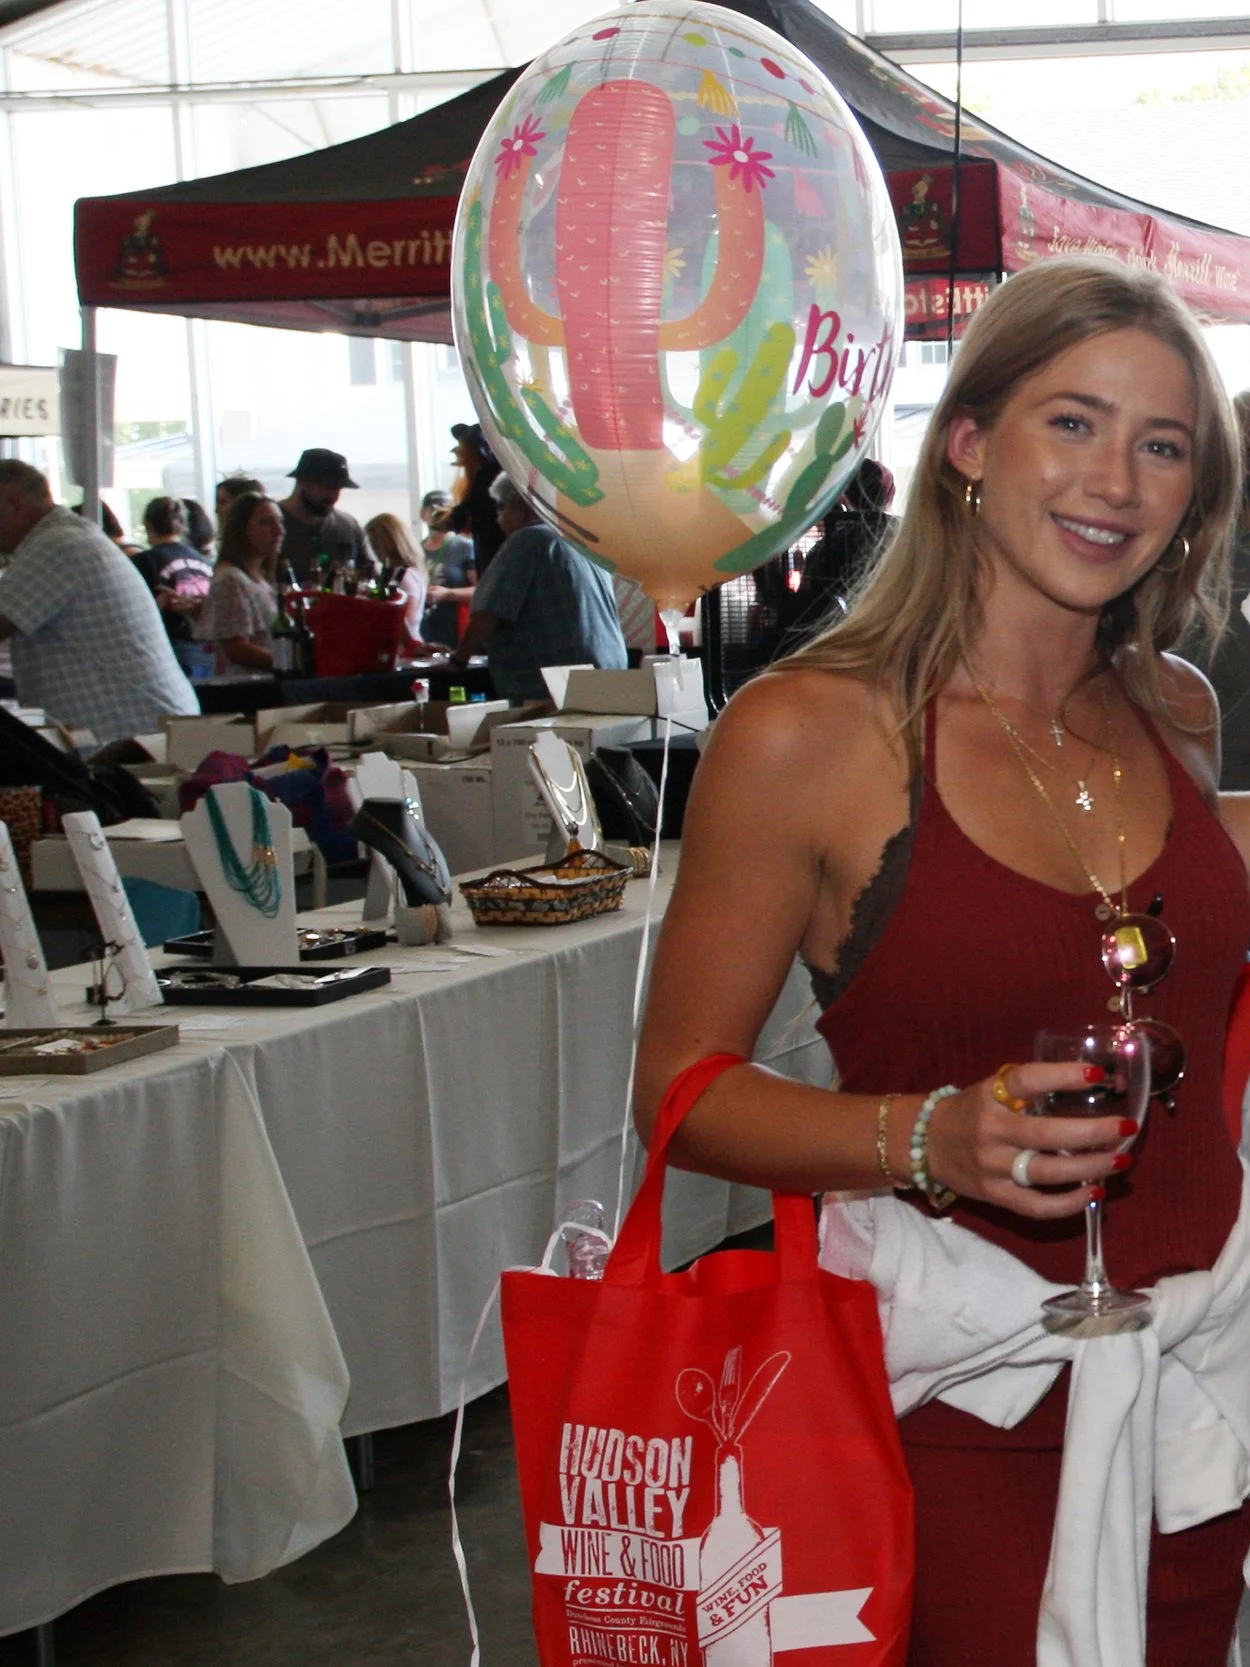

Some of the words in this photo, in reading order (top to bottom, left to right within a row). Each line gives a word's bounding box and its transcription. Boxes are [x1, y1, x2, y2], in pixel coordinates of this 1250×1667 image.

[212, 229, 452, 270] www.Merrit
[559, 1422, 692, 1488] HUDSON
[559, 1472, 690, 1538] VALLEY
[560, 1528, 613, 1576] WINE
[619, 1535, 637, 1578] &
[641, 1538, 685, 1589] FOOD
[564, 1580, 685, 1615] festival
[702, 1587, 739, 1613] WINE,
[738, 1562, 767, 1588] FOOD
[709, 1613, 725, 1627] &
[722, 1574, 768, 1618] FUN
[603, 1615, 636, 1626] County
[669, 1638, 688, 1667] NY
